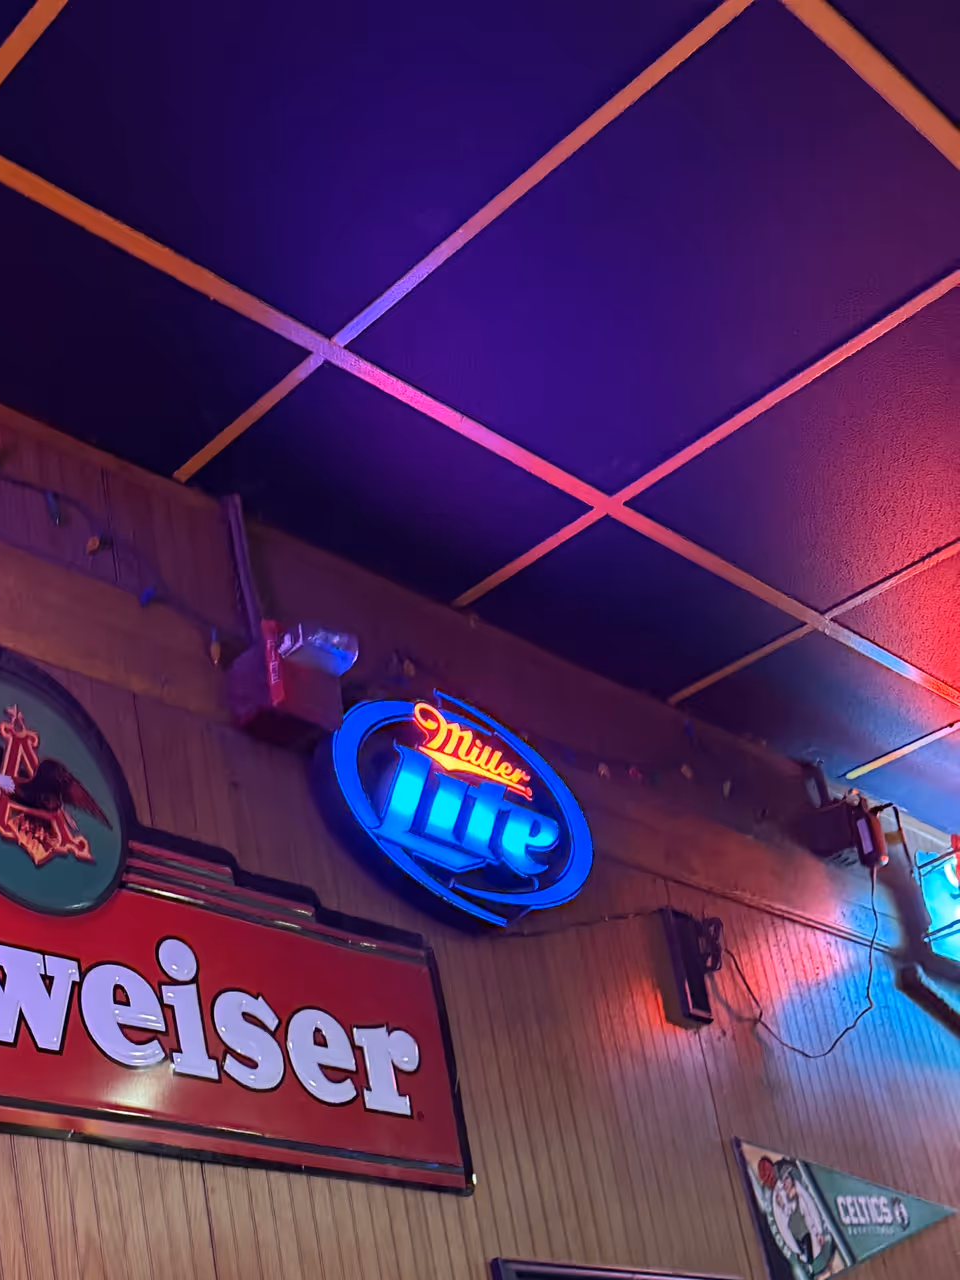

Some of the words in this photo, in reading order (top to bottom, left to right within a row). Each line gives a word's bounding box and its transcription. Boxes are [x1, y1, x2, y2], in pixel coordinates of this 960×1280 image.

[413, 701, 531, 790] Miller
[372, 740, 560, 877] Lite
[836, 1194, 894, 1225] CELTICS
